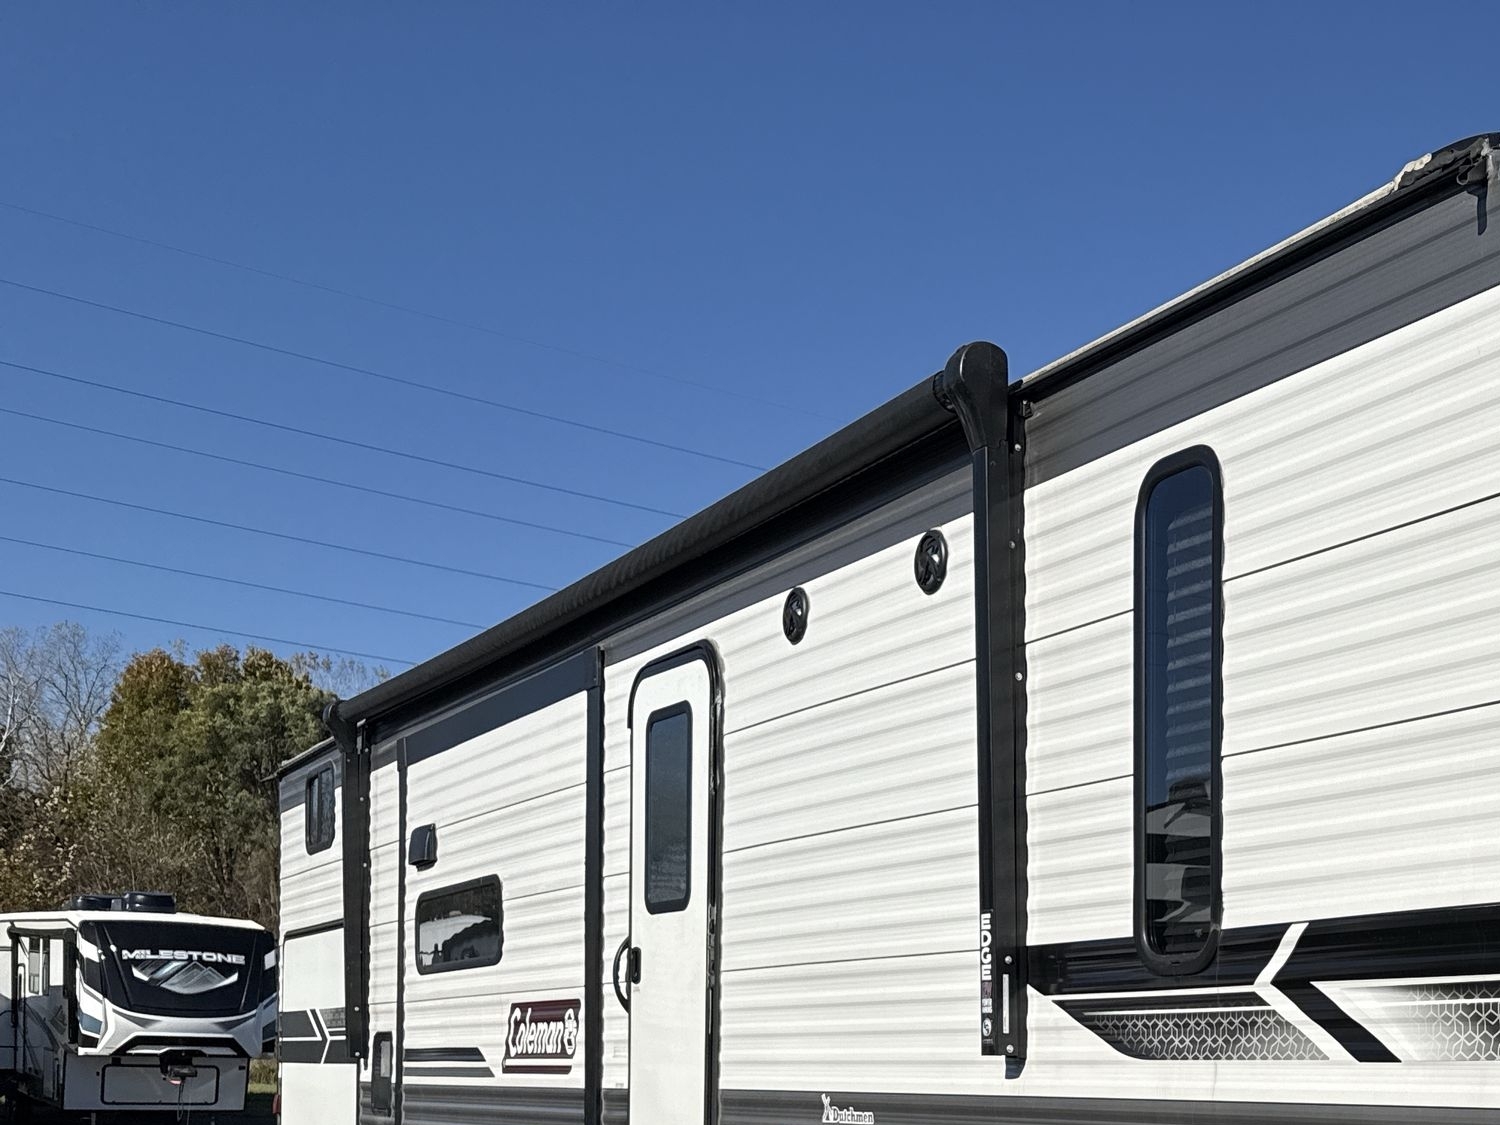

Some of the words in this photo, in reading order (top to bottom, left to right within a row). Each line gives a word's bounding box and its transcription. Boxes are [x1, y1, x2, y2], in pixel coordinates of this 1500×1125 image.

[121, 949, 246, 965] MILESTONE
[980, 912, 993, 981] EDGE
[507, 1007, 564, 1058] Coleman
[832, 1106, 874, 1124] Dutchmen
